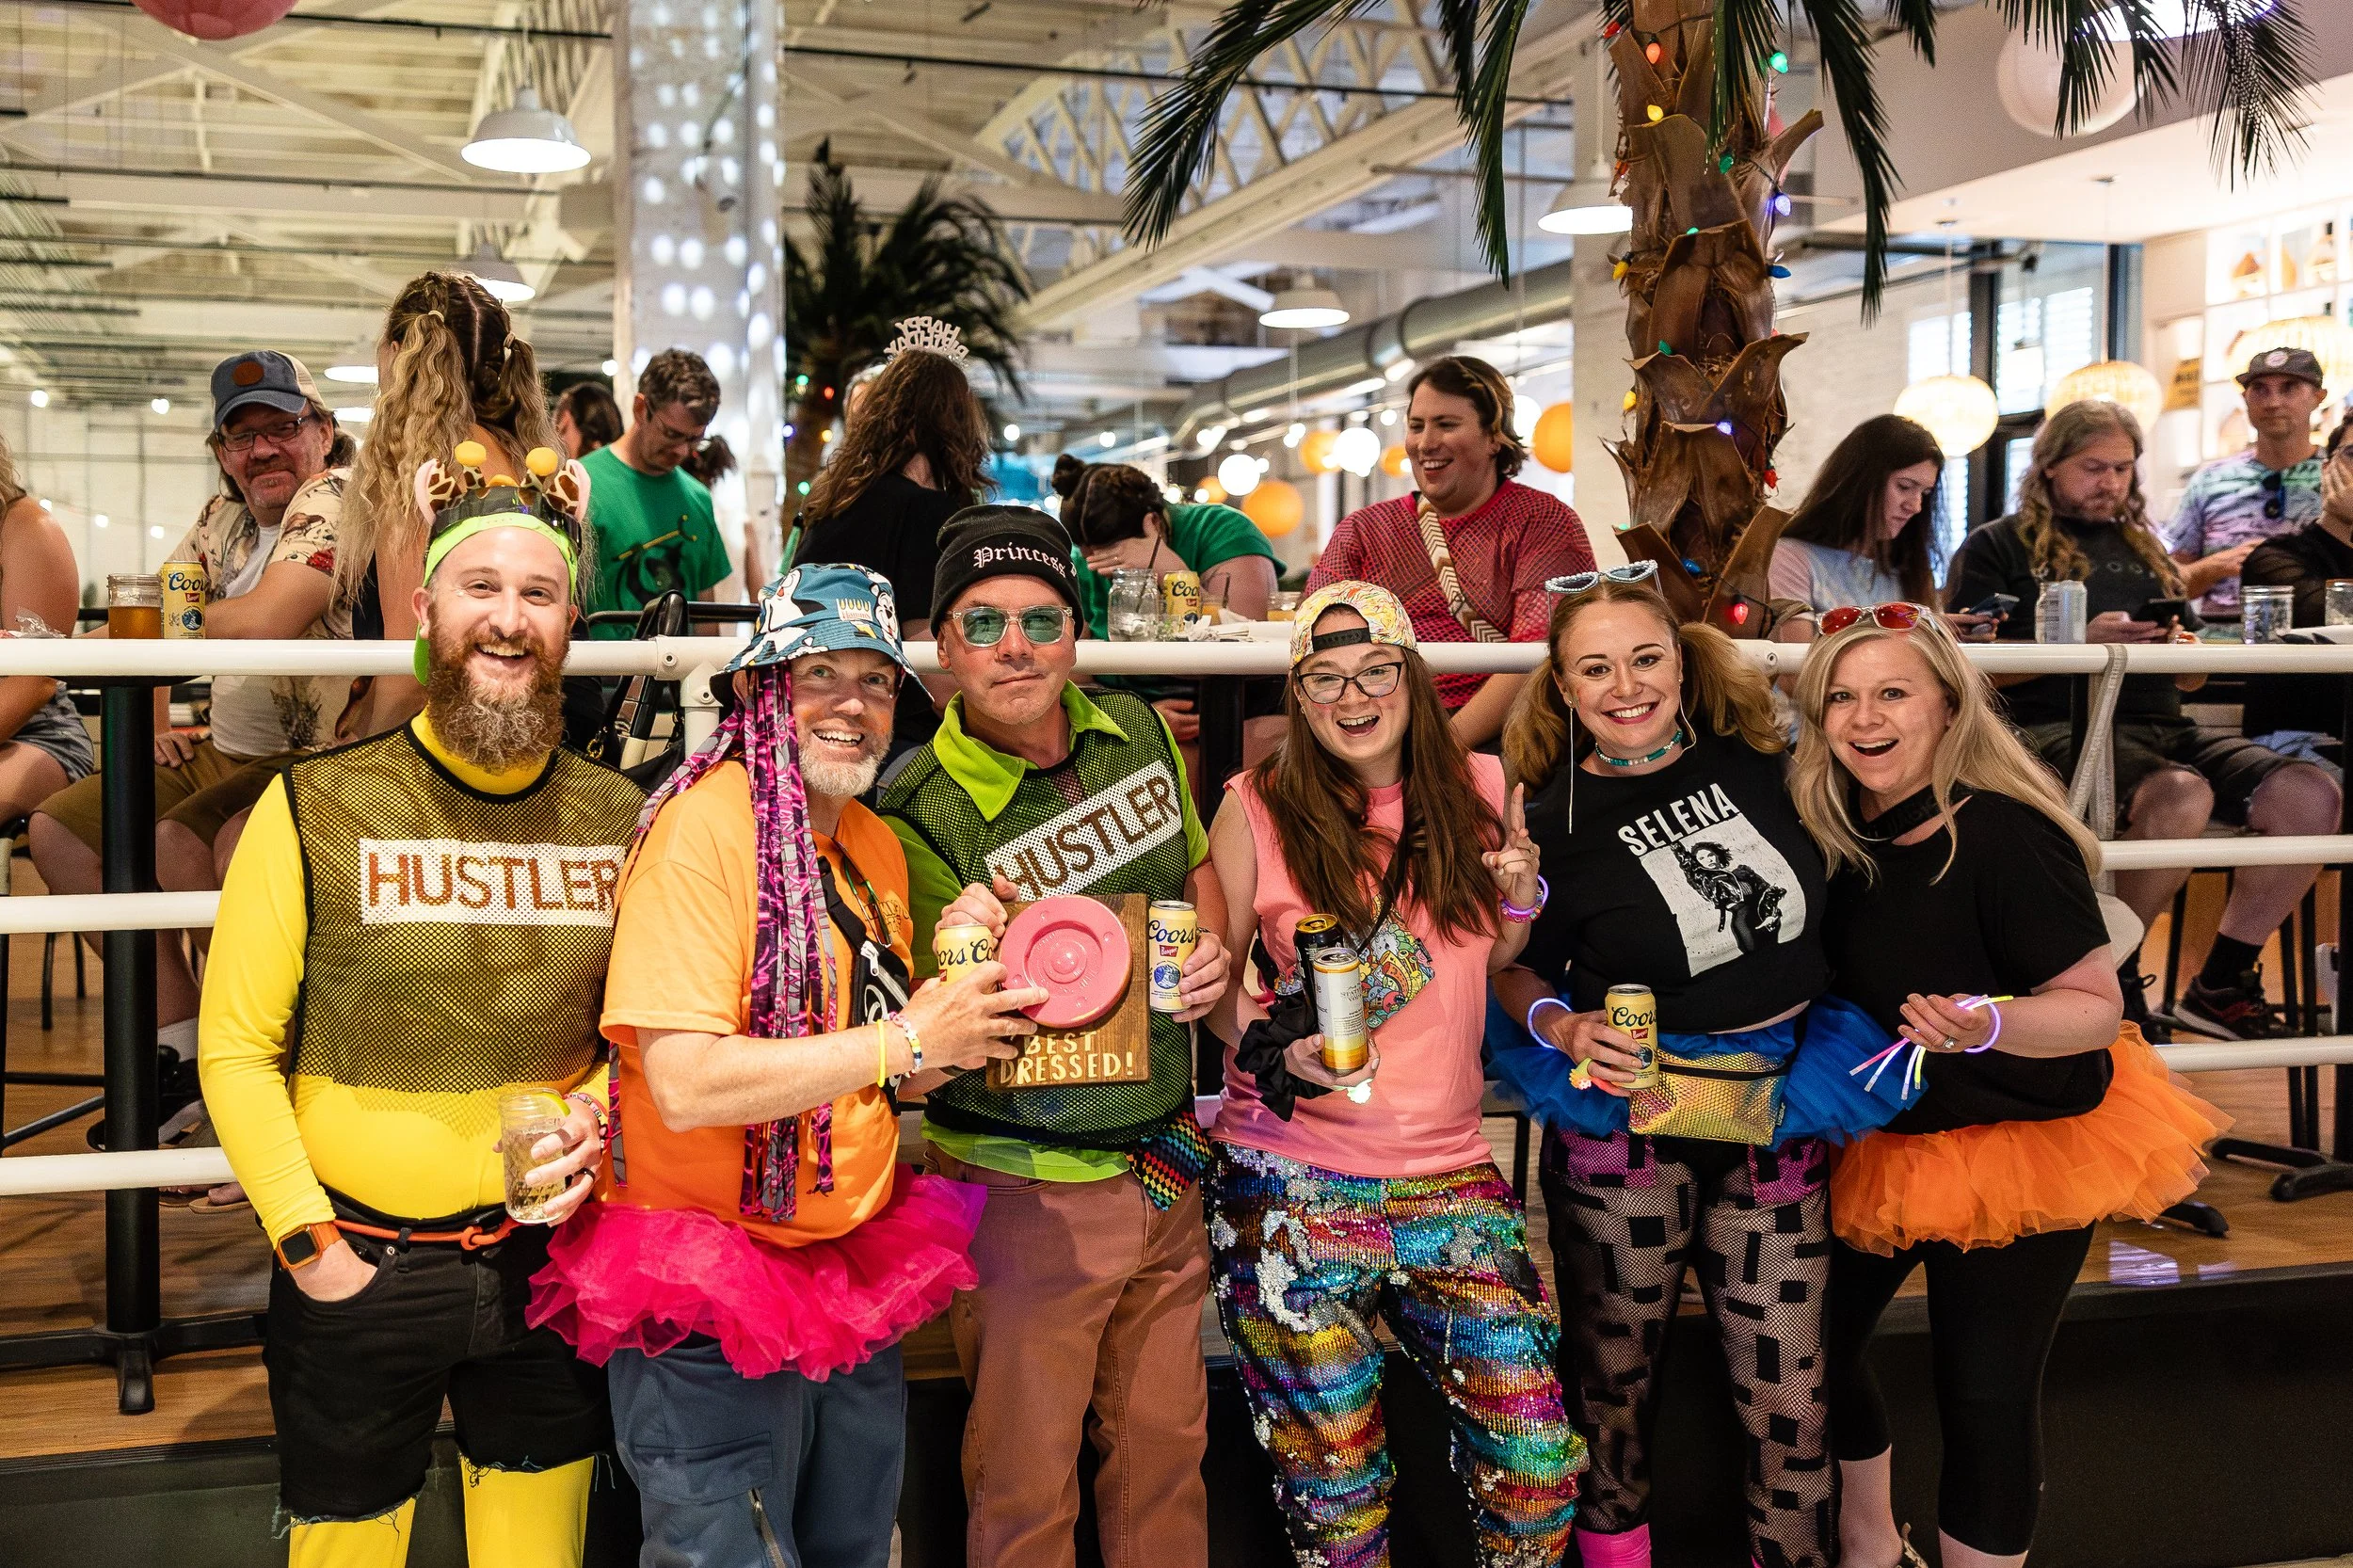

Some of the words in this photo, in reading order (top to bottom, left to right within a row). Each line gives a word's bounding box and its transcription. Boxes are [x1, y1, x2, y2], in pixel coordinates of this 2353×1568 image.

[973, 541, 1065, 579] Princess
[168, 572, 204, 591] Coo
[994, 776, 1178, 898] HUSTLER
[1617, 782, 1740, 856] SELENA
[368, 851, 620, 912] HUSTLER
[1148, 920, 1194, 944] Coors
[1023, 1032, 1096, 1055] BEST
[1000, 1050, 1133, 1085] DRESSED!
